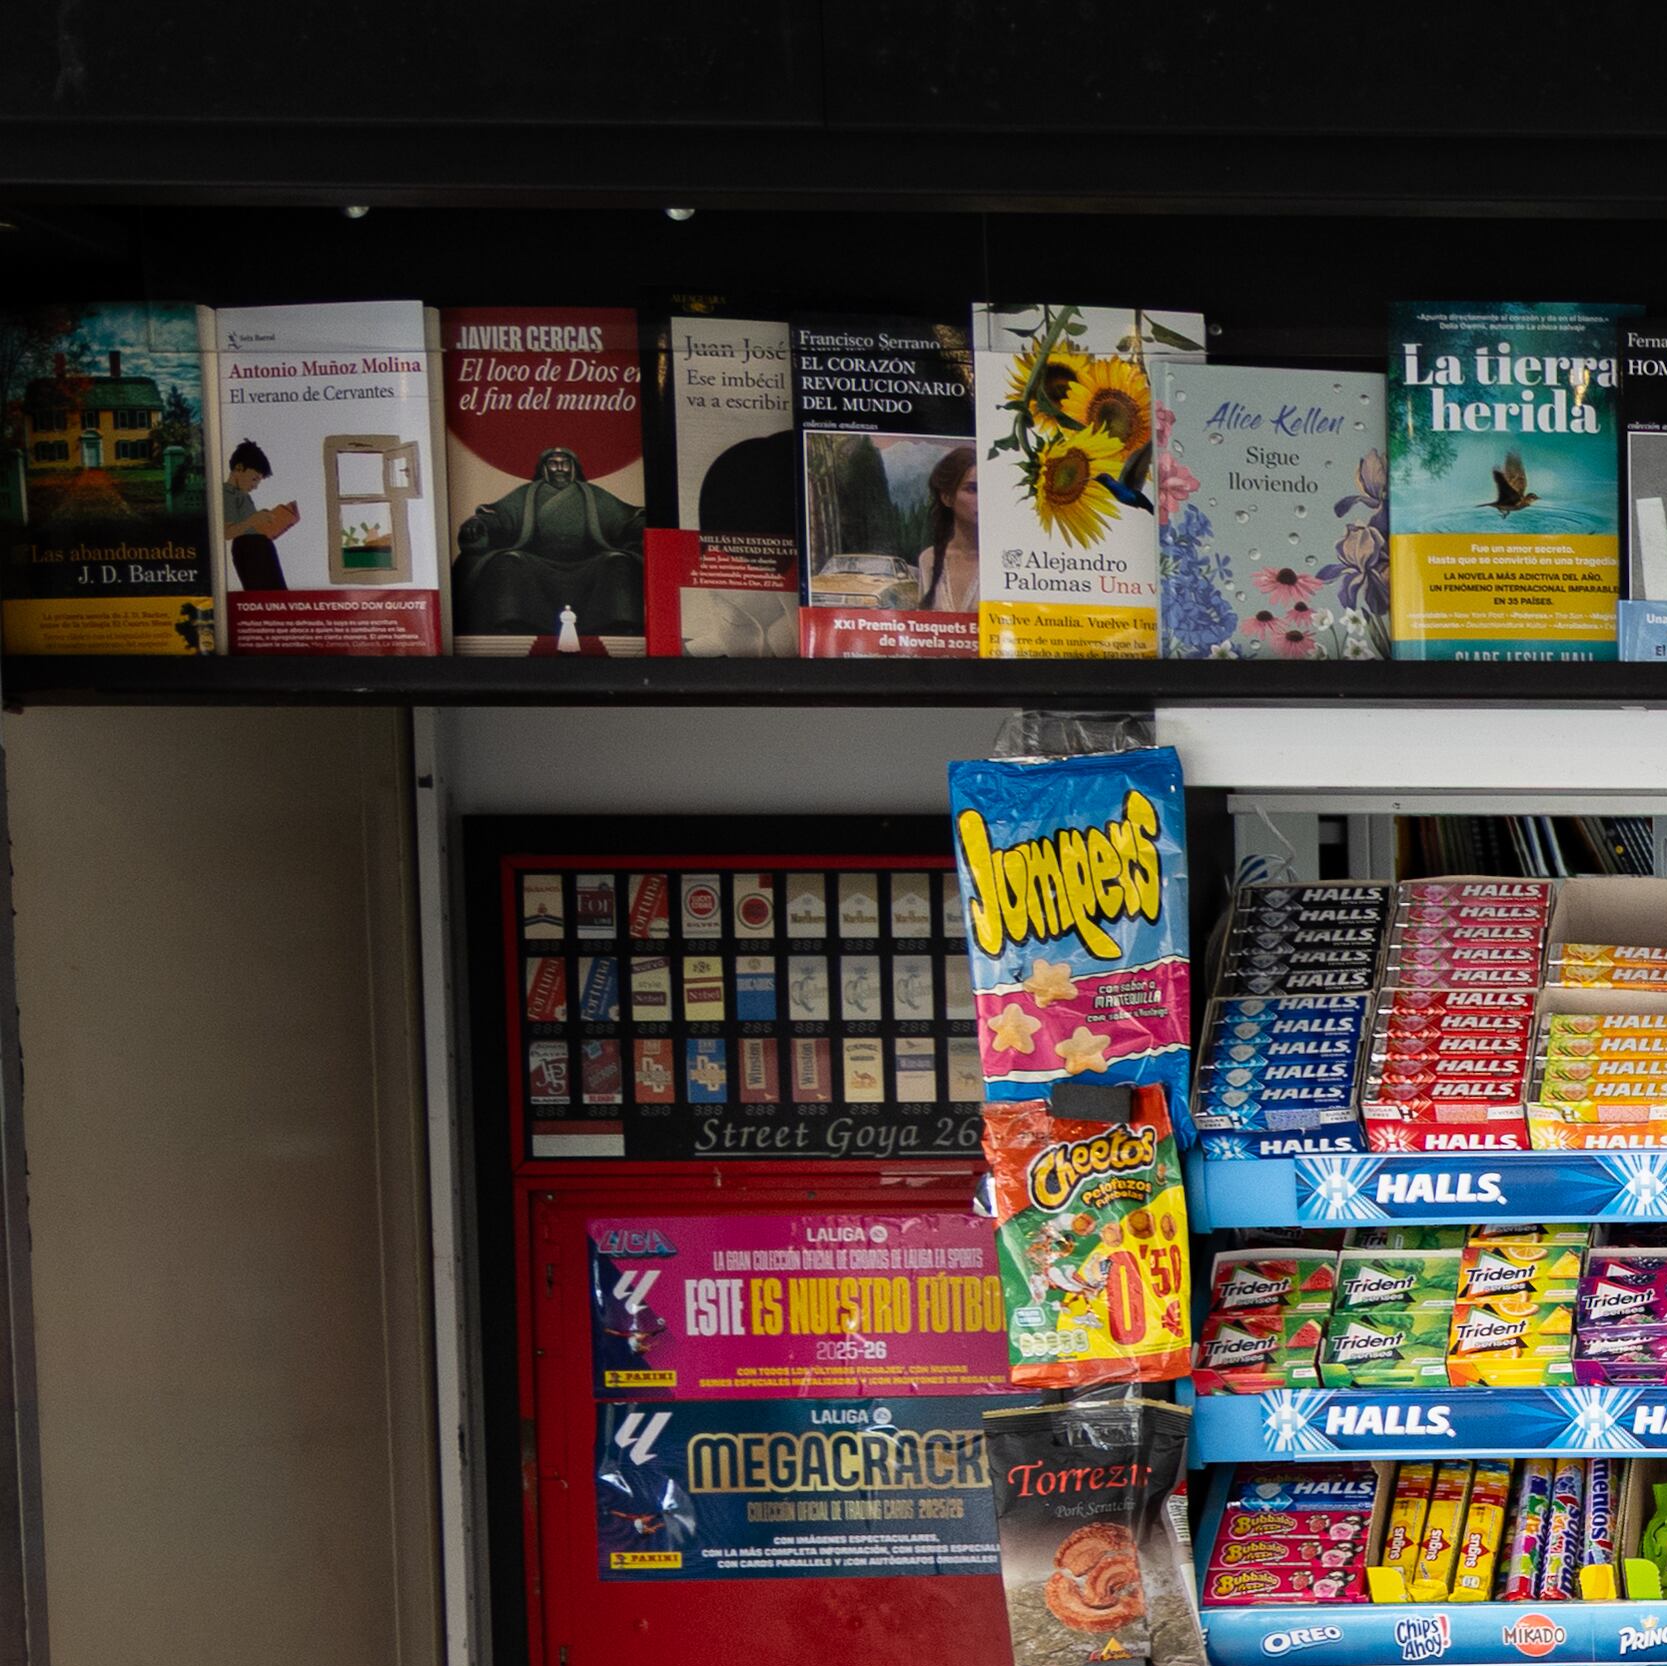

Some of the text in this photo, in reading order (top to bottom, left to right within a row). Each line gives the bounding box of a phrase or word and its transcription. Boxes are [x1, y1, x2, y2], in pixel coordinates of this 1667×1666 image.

[456, 326, 603, 352] JAVIER CERCAS
[229, 356, 422, 381] Antonio Muñoz Molina
[801, 355, 916, 375] EL CORAZÓN
[1403, 342, 1617, 387] La tierra
[230, 382, 394, 405] El verano de Cervantes
[802, 376, 965, 397] REVOLUCIONARIO
[459, 386, 636, 416] el fin del mundo
[802, 396, 912, 414] DEL MUNDO
[1431, 388, 1601, 434] herida
[1246, 447, 1300, 471] Sigue
[1228, 471, 1318, 494] lloviendo
[695, 1119, 808, 1150] Street
[826, 1117, 920, 1158] Goya
[1031, 1125, 1156, 1210] Cheetos
[807, 1227, 865, 1243] LALIGA
[1220, 1278, 1291, 1299] Trident
[1343, 1275, 1414, 1296] Trident
[685, 1277, 911, 1336] ESTE ES NUESTRO
[811, 1409, 869, 1424] LALIGA
[1262, 1626, 1342, 1655] OREO
[1396, 1617, 1440, 1644] Chips
[1504, 1626, 1565, 1645] MIKADO
